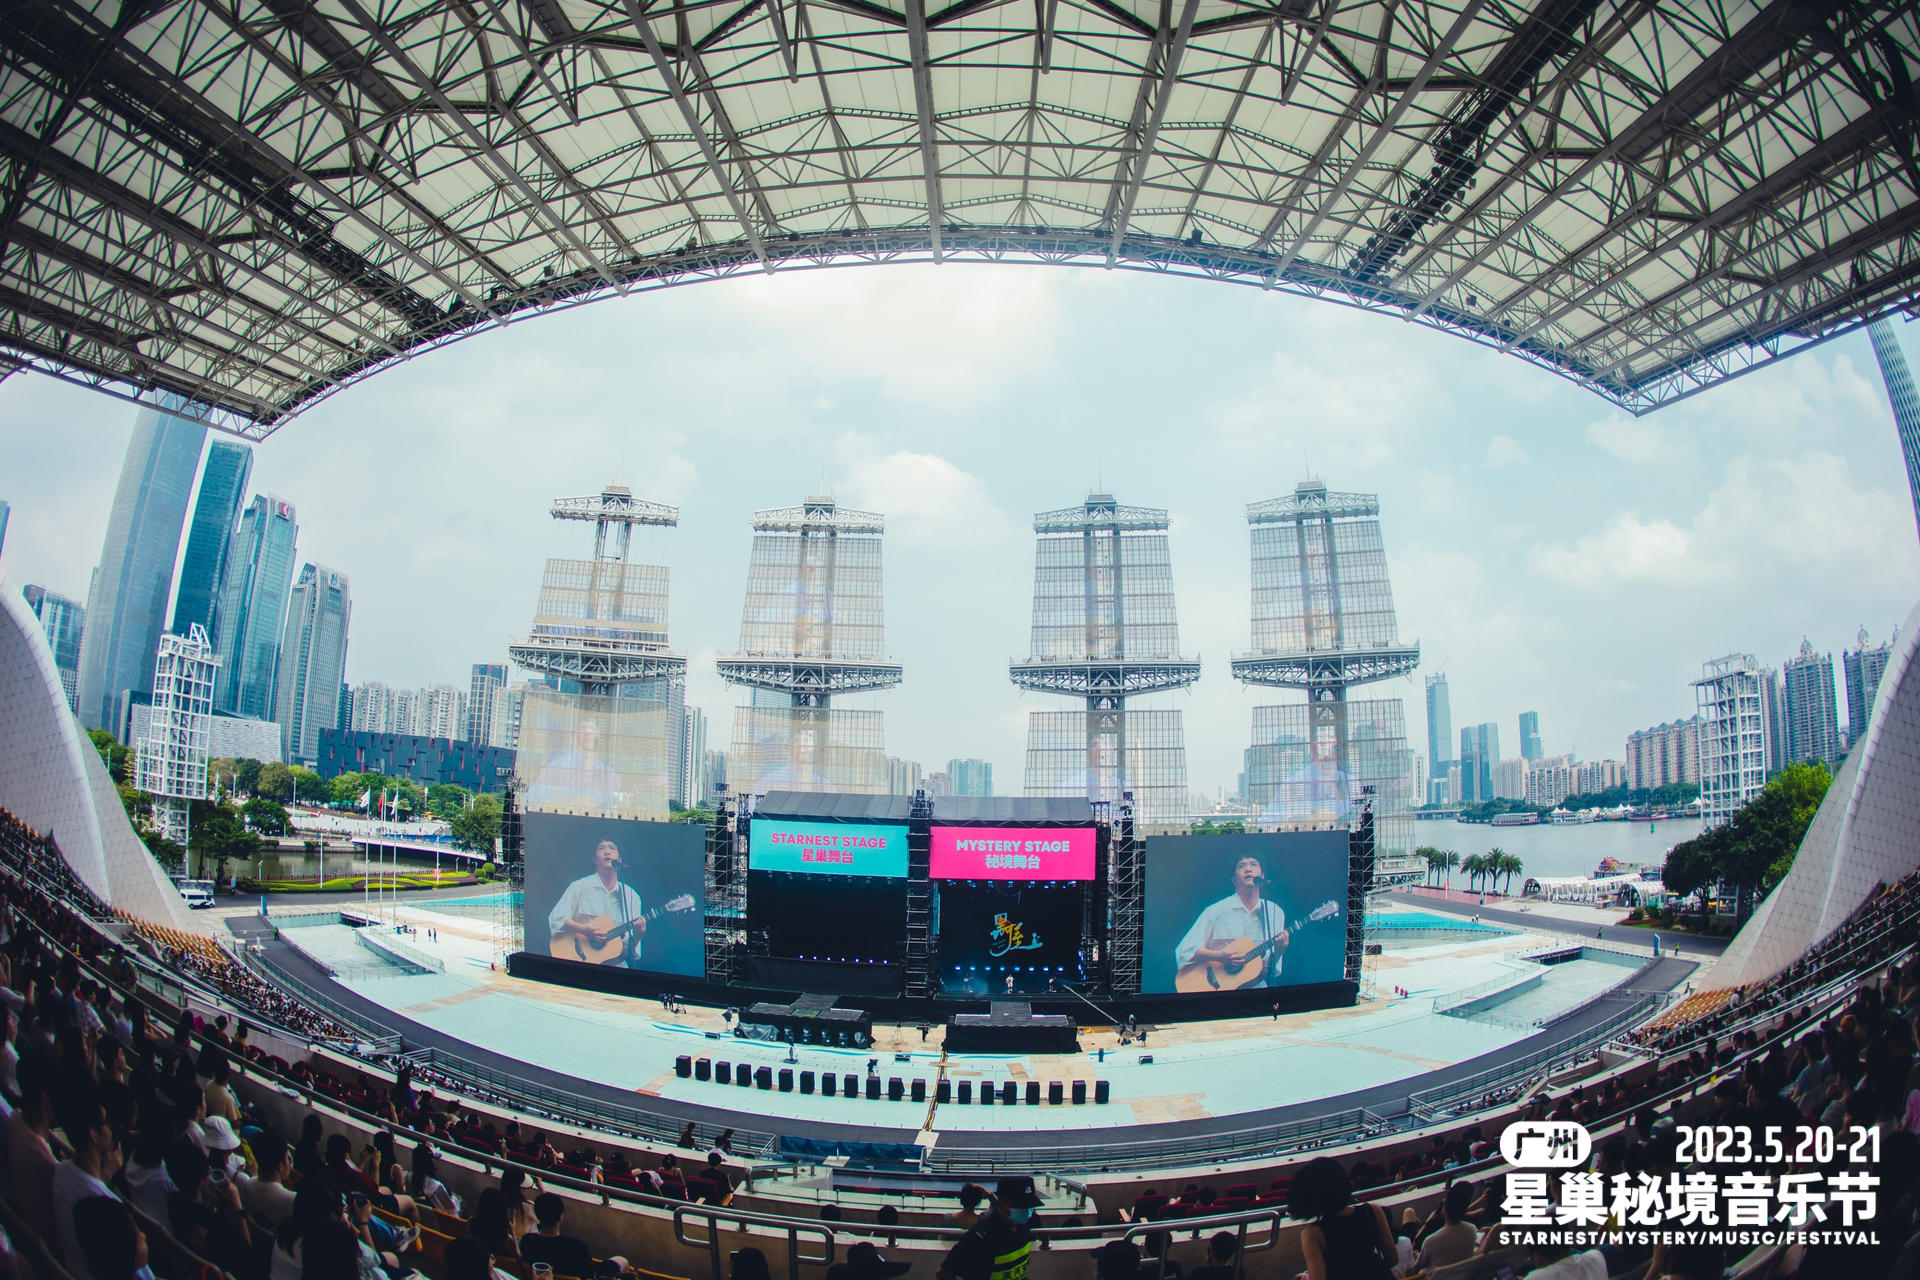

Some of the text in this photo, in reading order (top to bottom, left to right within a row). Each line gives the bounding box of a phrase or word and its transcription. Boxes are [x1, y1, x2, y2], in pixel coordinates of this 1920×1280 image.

[771, 833, 886, 849] STARNEST STAGE
[956, 839, 1071, 853] MYSTERY STAGE
[801, 848, 854, 864] 星巢舞台
[985, 854, 1041, 869] 秘境舞台
